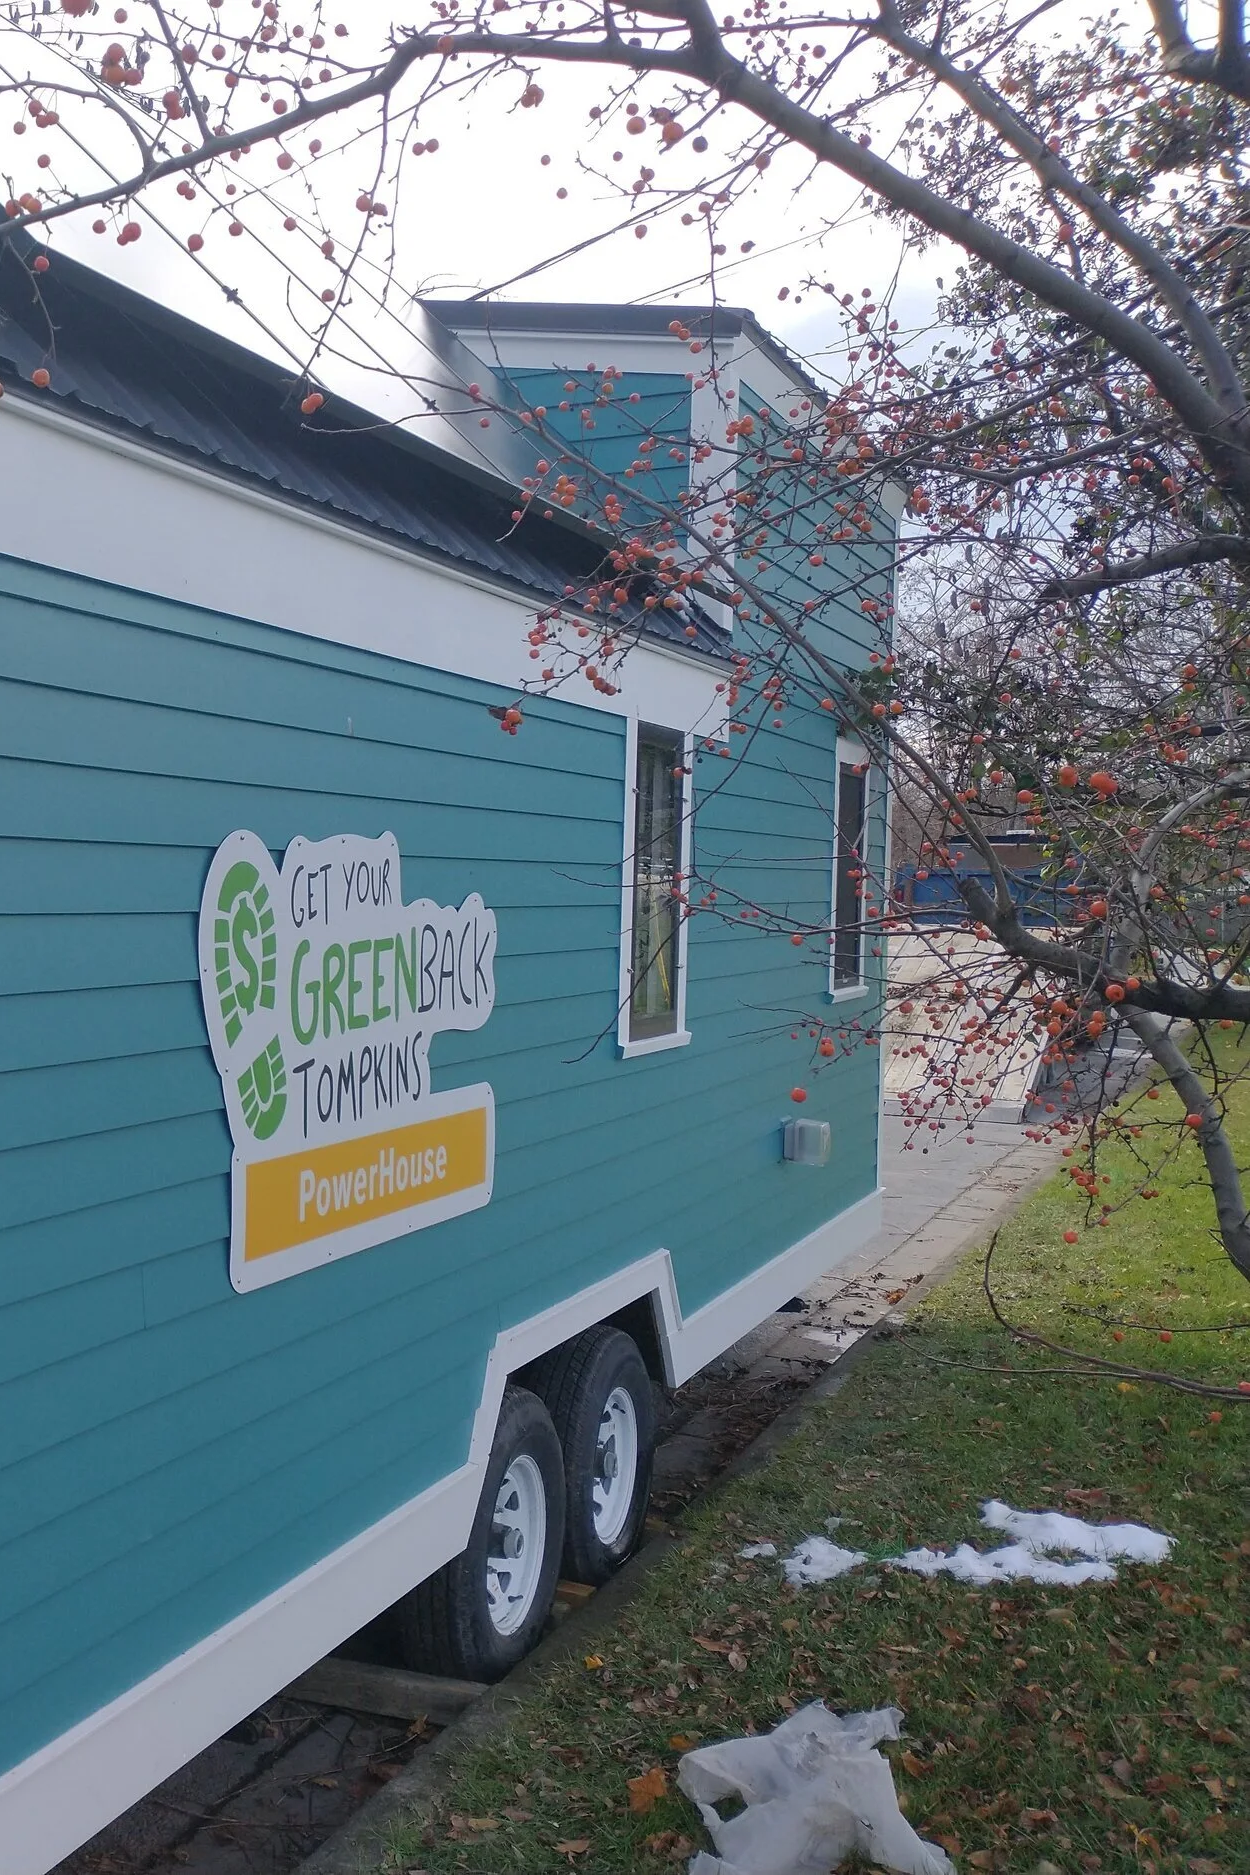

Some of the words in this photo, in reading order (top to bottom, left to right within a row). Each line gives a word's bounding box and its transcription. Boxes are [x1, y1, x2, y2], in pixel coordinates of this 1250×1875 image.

[290, 863, 332, 929] GET
[342, 858, 393, 912] YOUR
[290, 916, 491, 1046] GREENBACK
[292, 1030, 424, 1139] TOMPKINS
[298, 1143, 448, 1223] PowerHouse
